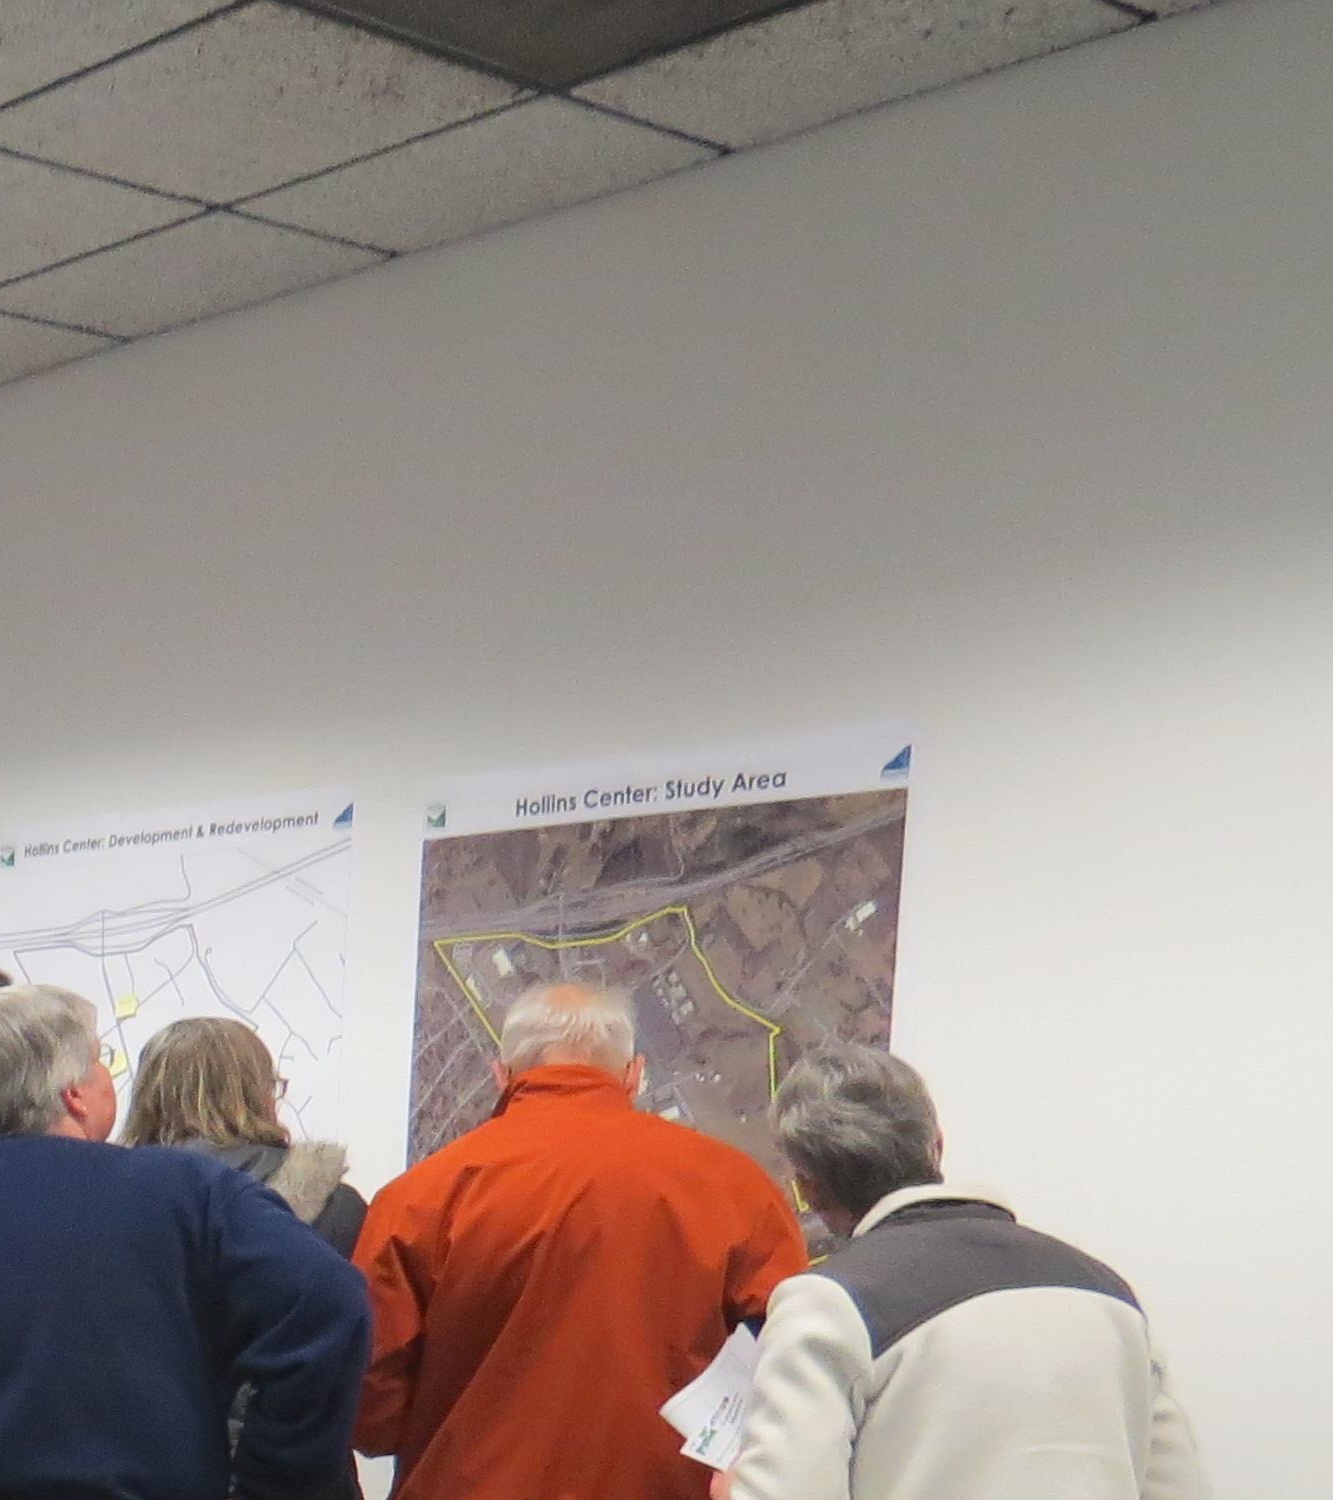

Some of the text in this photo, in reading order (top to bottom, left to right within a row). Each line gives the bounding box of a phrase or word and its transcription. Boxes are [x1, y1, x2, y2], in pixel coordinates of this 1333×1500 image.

[515, 770, 787, 818] Hollins Center: Study Area
[23, 811, 319, 859] Hollins Center: Development & Redevelopment
